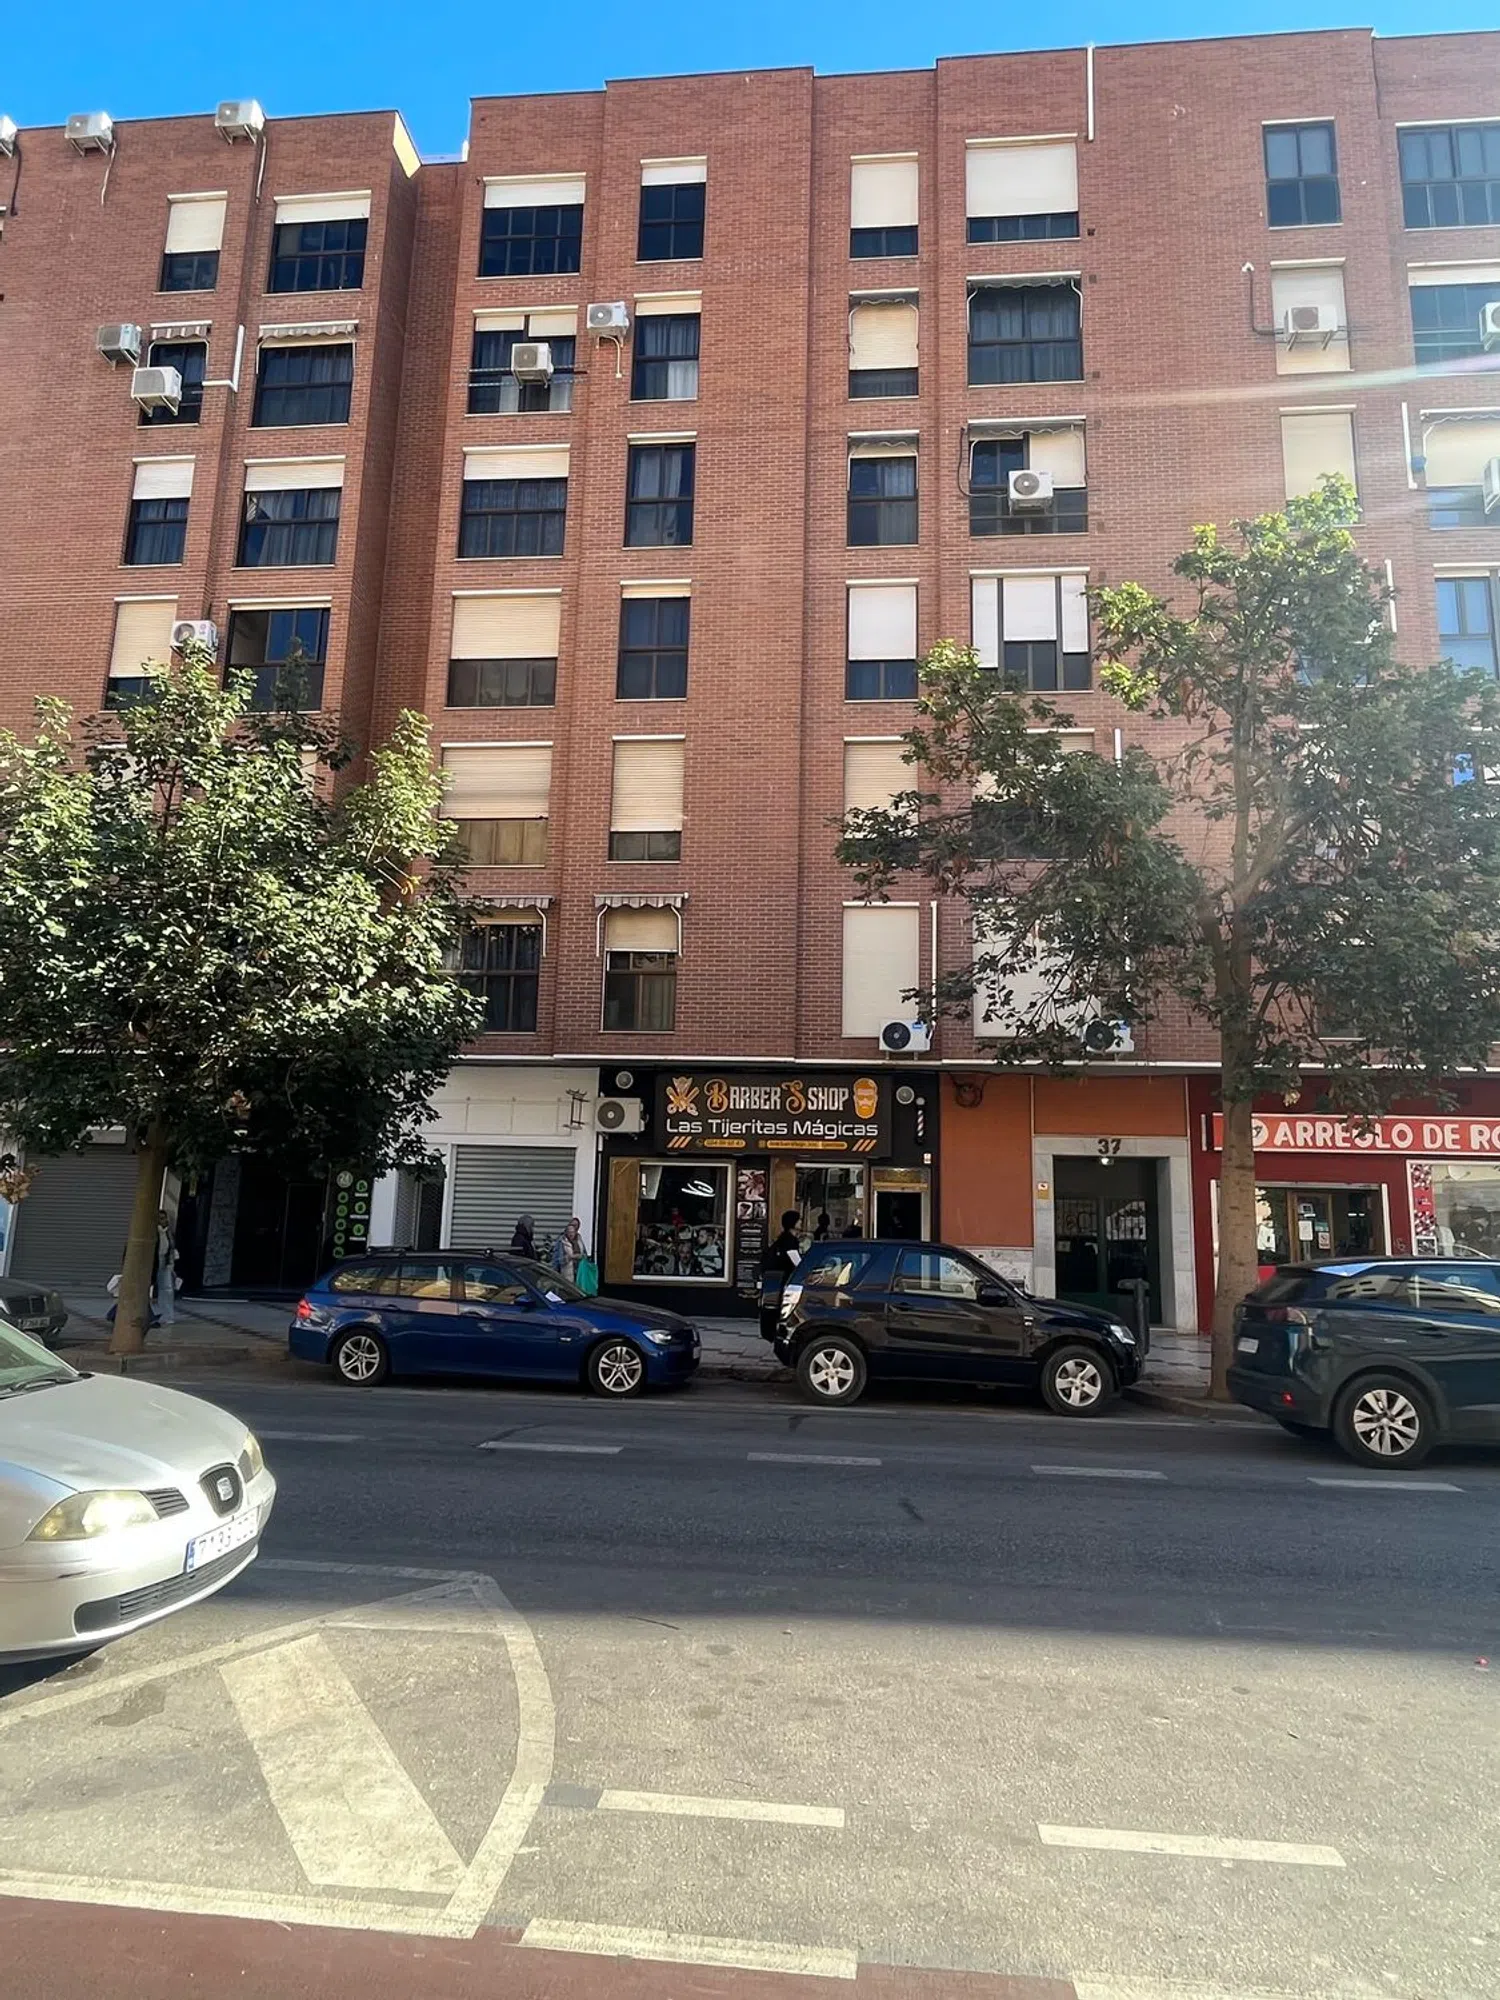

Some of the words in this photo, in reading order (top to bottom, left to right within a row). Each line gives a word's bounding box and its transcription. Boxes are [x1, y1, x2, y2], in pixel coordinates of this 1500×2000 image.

[666, 1119, 703, 1133] Las
[708, 1119, 788, 1137] Tijeritas
[793, 1119, 879, 1139] Mágicas
[1273, 1121, 1414, 1149] ARREGLO
[1422, 1123, 1461, 1150] DE
[1098, 1138, 1121, 1155] 37
